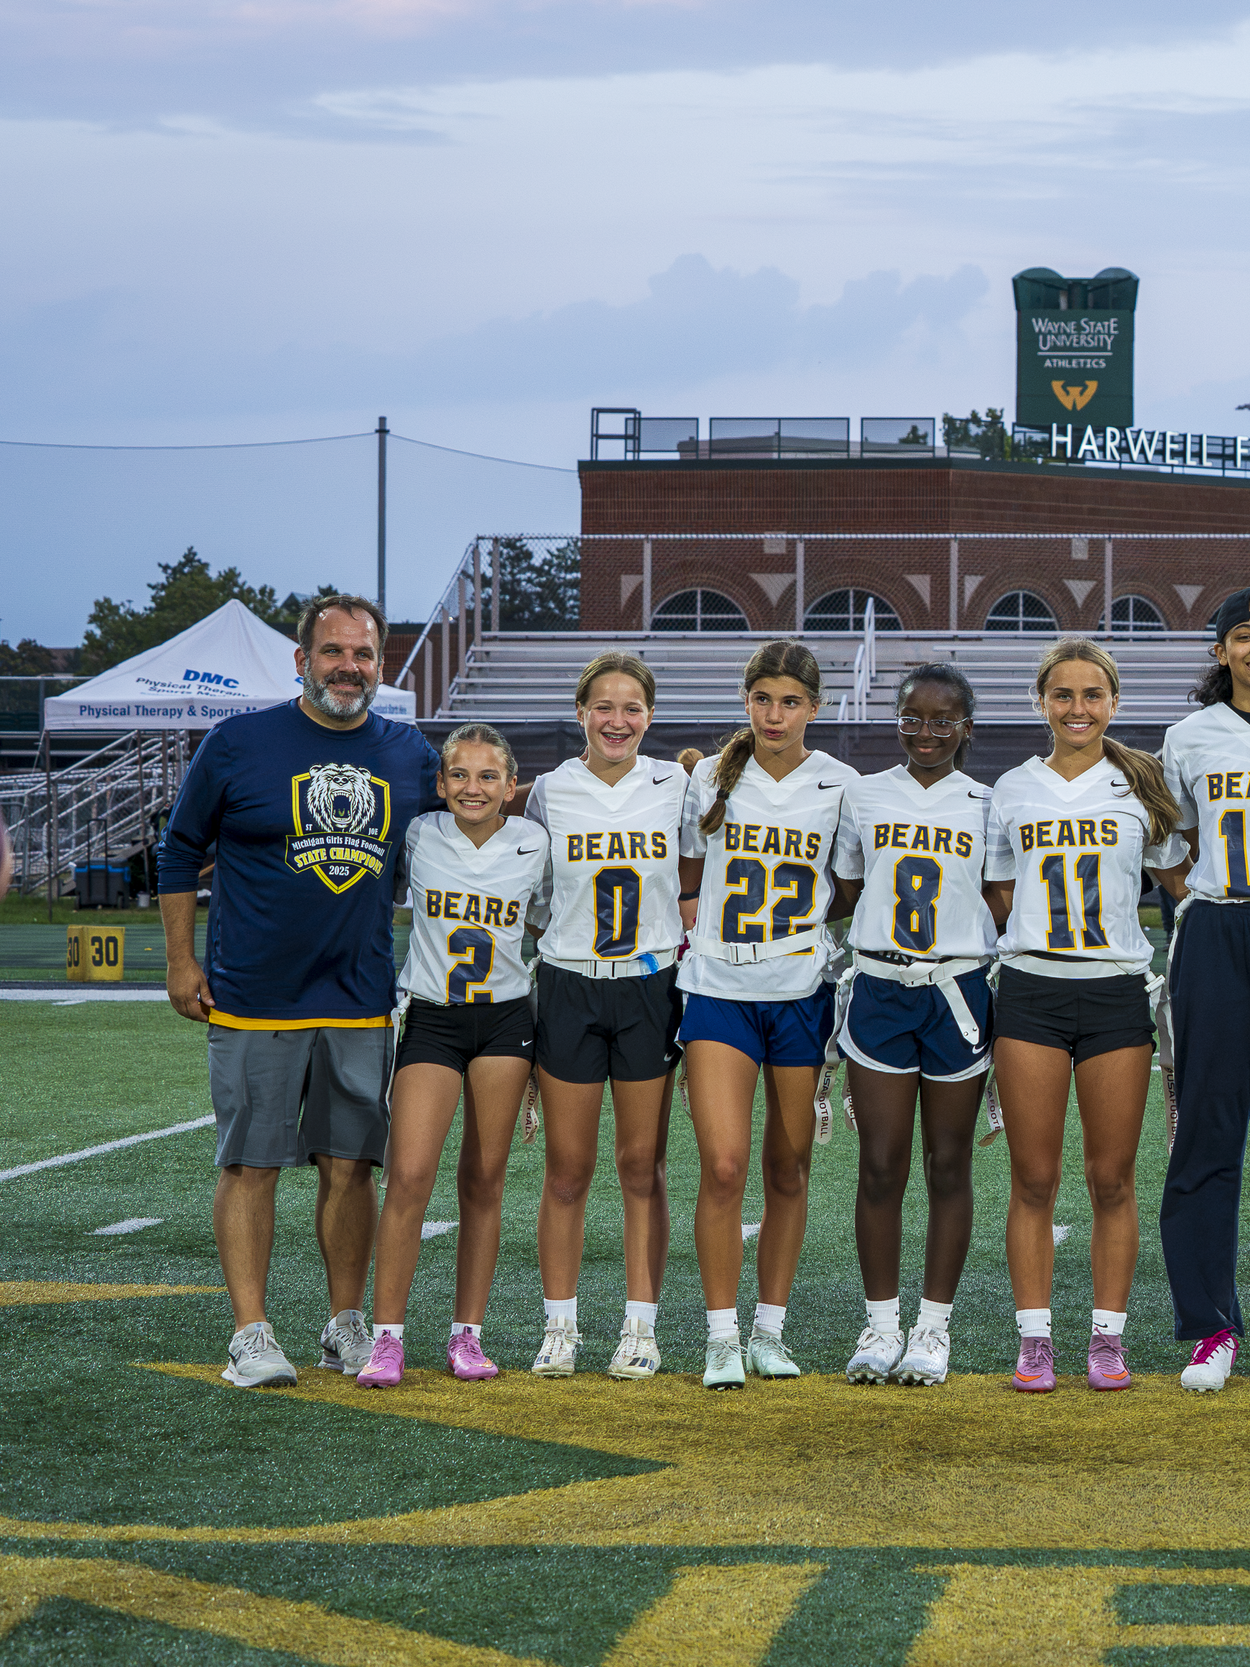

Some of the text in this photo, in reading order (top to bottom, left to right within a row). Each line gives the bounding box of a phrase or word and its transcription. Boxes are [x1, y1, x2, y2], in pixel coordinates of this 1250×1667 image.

[1031, 318, 1119, 334] WAYNE STATE
[1038, 334, 1115, 351] UNIVERSITY
[1043, 358, 1106, 368] ATHLETICS
[1051, 423, 1213, 467] HARWELL
[136, 677, 191, 690] Physical
[183, 669, 240, 688] DMC
[79, 705, 131, 719] Physical
[135, 705, 184, 719] Therapy
[187, 706, 197, 716] &
[200, 706, 242, 719] Sports
[291, 836, 385, 857] Michigan Girls Flag Football
[368, 828, 379, 836] JOE
[567, 831, 667, 862] BEARS
[724, 822, 821, 860] BEARS
[874, 822, 973, 859] BEARS
[1019, 819, 1119, 852] BEARS
[294, 848, 328, 868] STATE
[328, 865, 350, 876] 2025
[425, 889, 521, 927] BEARS
[592, 865, 642, 960] 0
[720, 856, 818, 955] 22
[891, 853, 943, 954] 8
[1039, 852, 1110, 951] 11
[68, 936, 79, 967] 30
[91, 936, 118, 967] 30
[446, 925, 495, 1004] 2
